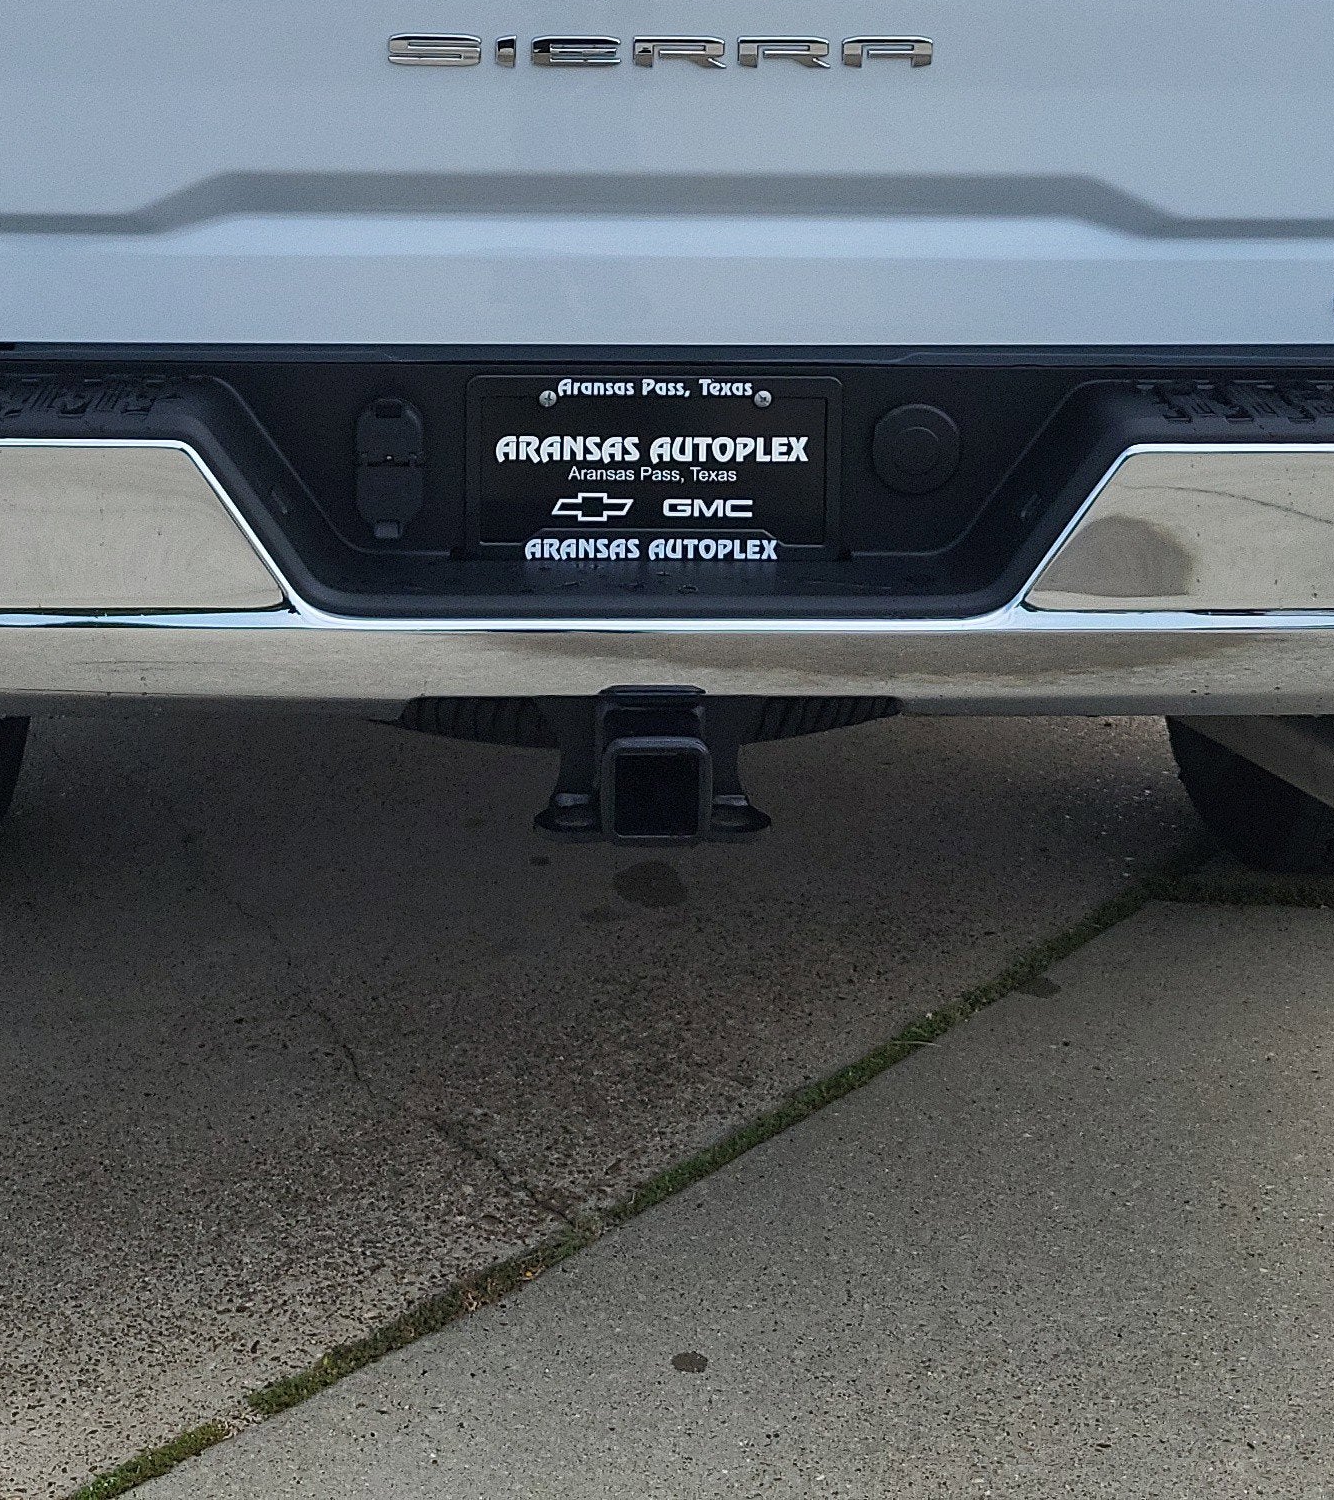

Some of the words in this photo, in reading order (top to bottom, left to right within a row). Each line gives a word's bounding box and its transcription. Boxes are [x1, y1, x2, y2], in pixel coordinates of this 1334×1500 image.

[387, 33, 934, 69] SIERRA
[556, 378, 635, 397] Aransas
[641, 378, 691, 398] Pass,
[698, 378, 753, 397] Texas
[495, 435, 640, 464] ARANSAS
[649, 435, 809, 463] AUTOPLEX
[567, 466, 635, 482] Aransas
[640, 466, 685, 484] Pass,
[690, 467, 738, 483] Texas
[662, 499, 754, 518] GMC
[524, 538, 640, 561] ARANSAS
[648, 538, 779, 561] AUTOPLEX
